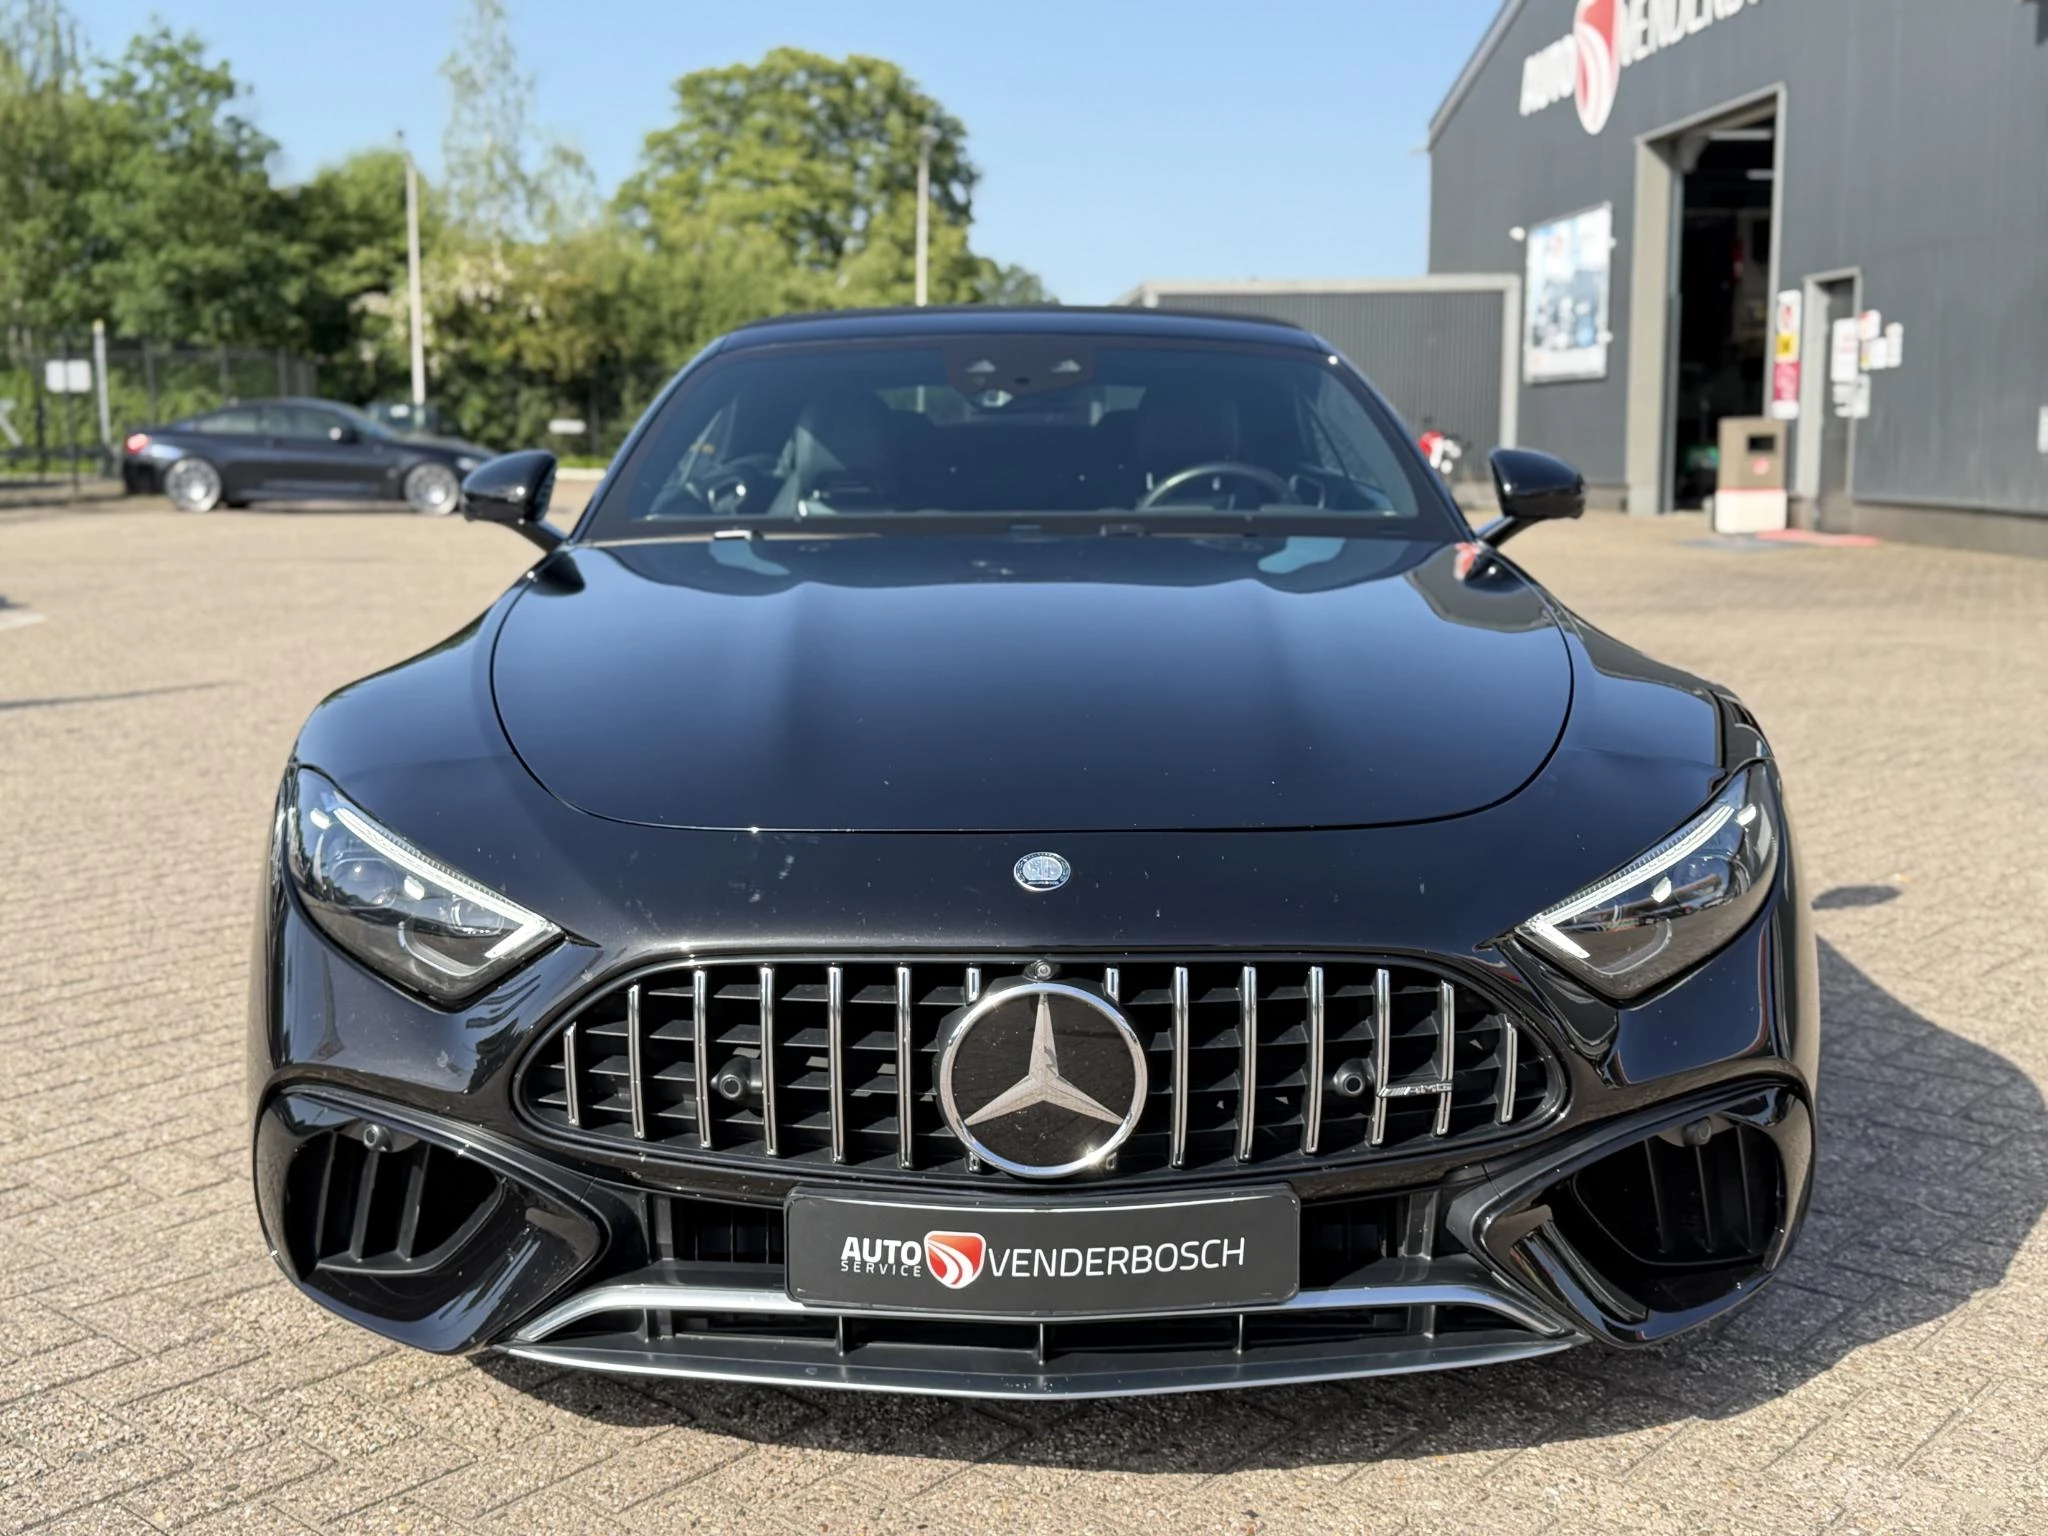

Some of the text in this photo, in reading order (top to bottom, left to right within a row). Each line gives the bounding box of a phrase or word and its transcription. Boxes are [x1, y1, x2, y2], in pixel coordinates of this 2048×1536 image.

[840, 1236, 922, 1266] AUTO
[987, 1236, 1246, 1278] VENDERBOSCH
[840, 1260, 922, 1278] SERVICE
